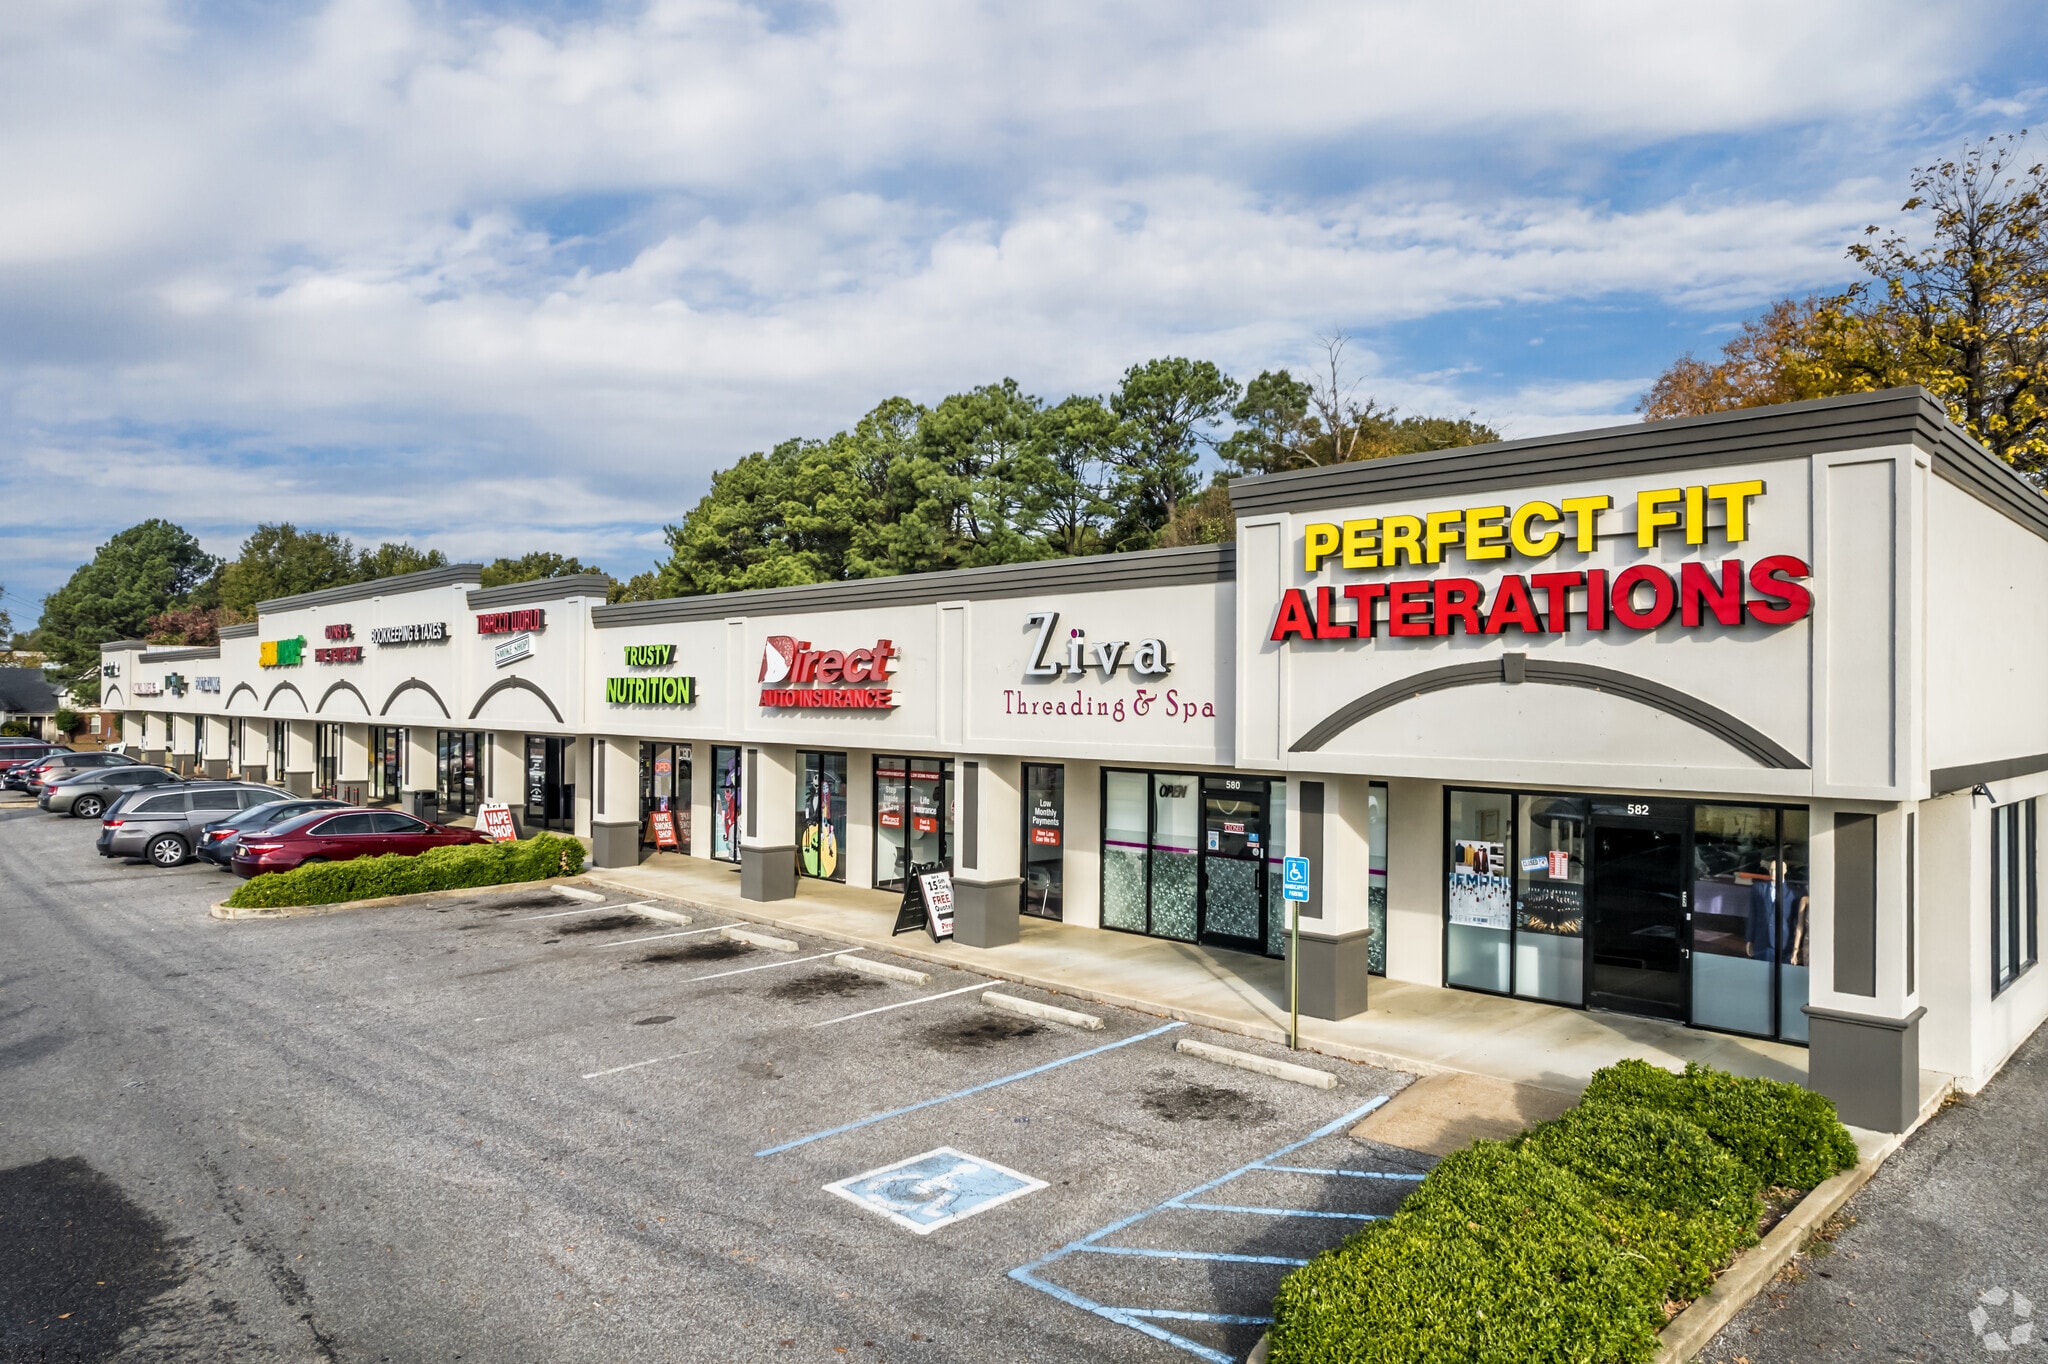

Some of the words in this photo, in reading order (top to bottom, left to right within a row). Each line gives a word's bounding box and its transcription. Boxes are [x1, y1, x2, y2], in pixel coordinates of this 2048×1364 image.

[1304, 493, 1614, 573] PERFECT
[1637, 479, 1765, 549] FIT
[1270, 554, 1814, 642] ALTERATIONS
[476, 612, 509, 634] TOBACCO
[512, 608, 541, 631] WORLD
[325, 625, 342, 639] GUNS
[371, 625, 413, 643] BOOKKEEPING
[414, 625, 420, 640] &
[420, 622, 443, 640] TAXES
[1025, 612, 1171, 675] Ziva
[624, 644, 673, 666] TRUSTY
[758, 635, 895, 683] Direct
[606, 676, 692, 704] NUTRITION
[759, 689, 796, 707] AUTO
[799, 689, 890, 708] INSURANCE
[1003, 690, 1125, 722] Threading
[1133, 689, 1157, 716] &
[1166, 689, 1216, 723] Spa
[655, 761, 672, 772] OPEN
[885, 786, 897, 794] Step
[1226, 780, 1240, 790] 580
[1159, 784, 1188, 798] OPEN
[919, 796, 930, 805] Life
[1039, 799, 1052, 807] Low
[913, 805, 937, 815] Insurance
[1034, 807, 1057, 818] Monthly
[1627, 804, 1649, 815] 582
[486, 811, 510, 825] VAPE
[654, 813, 669, 822] VAPE
[1032, 816, 1060, 826] Payments
[488, 825, 513, 838] SHOP
[654, 822, 673, 830] SMOKE
[1224, 824, 1244, 832] CLOSED
[657, 830, 672, 838] SHOP
[1522, 859, 1539, 867] CLOSED
[932, 894, 951, 905] FREE
